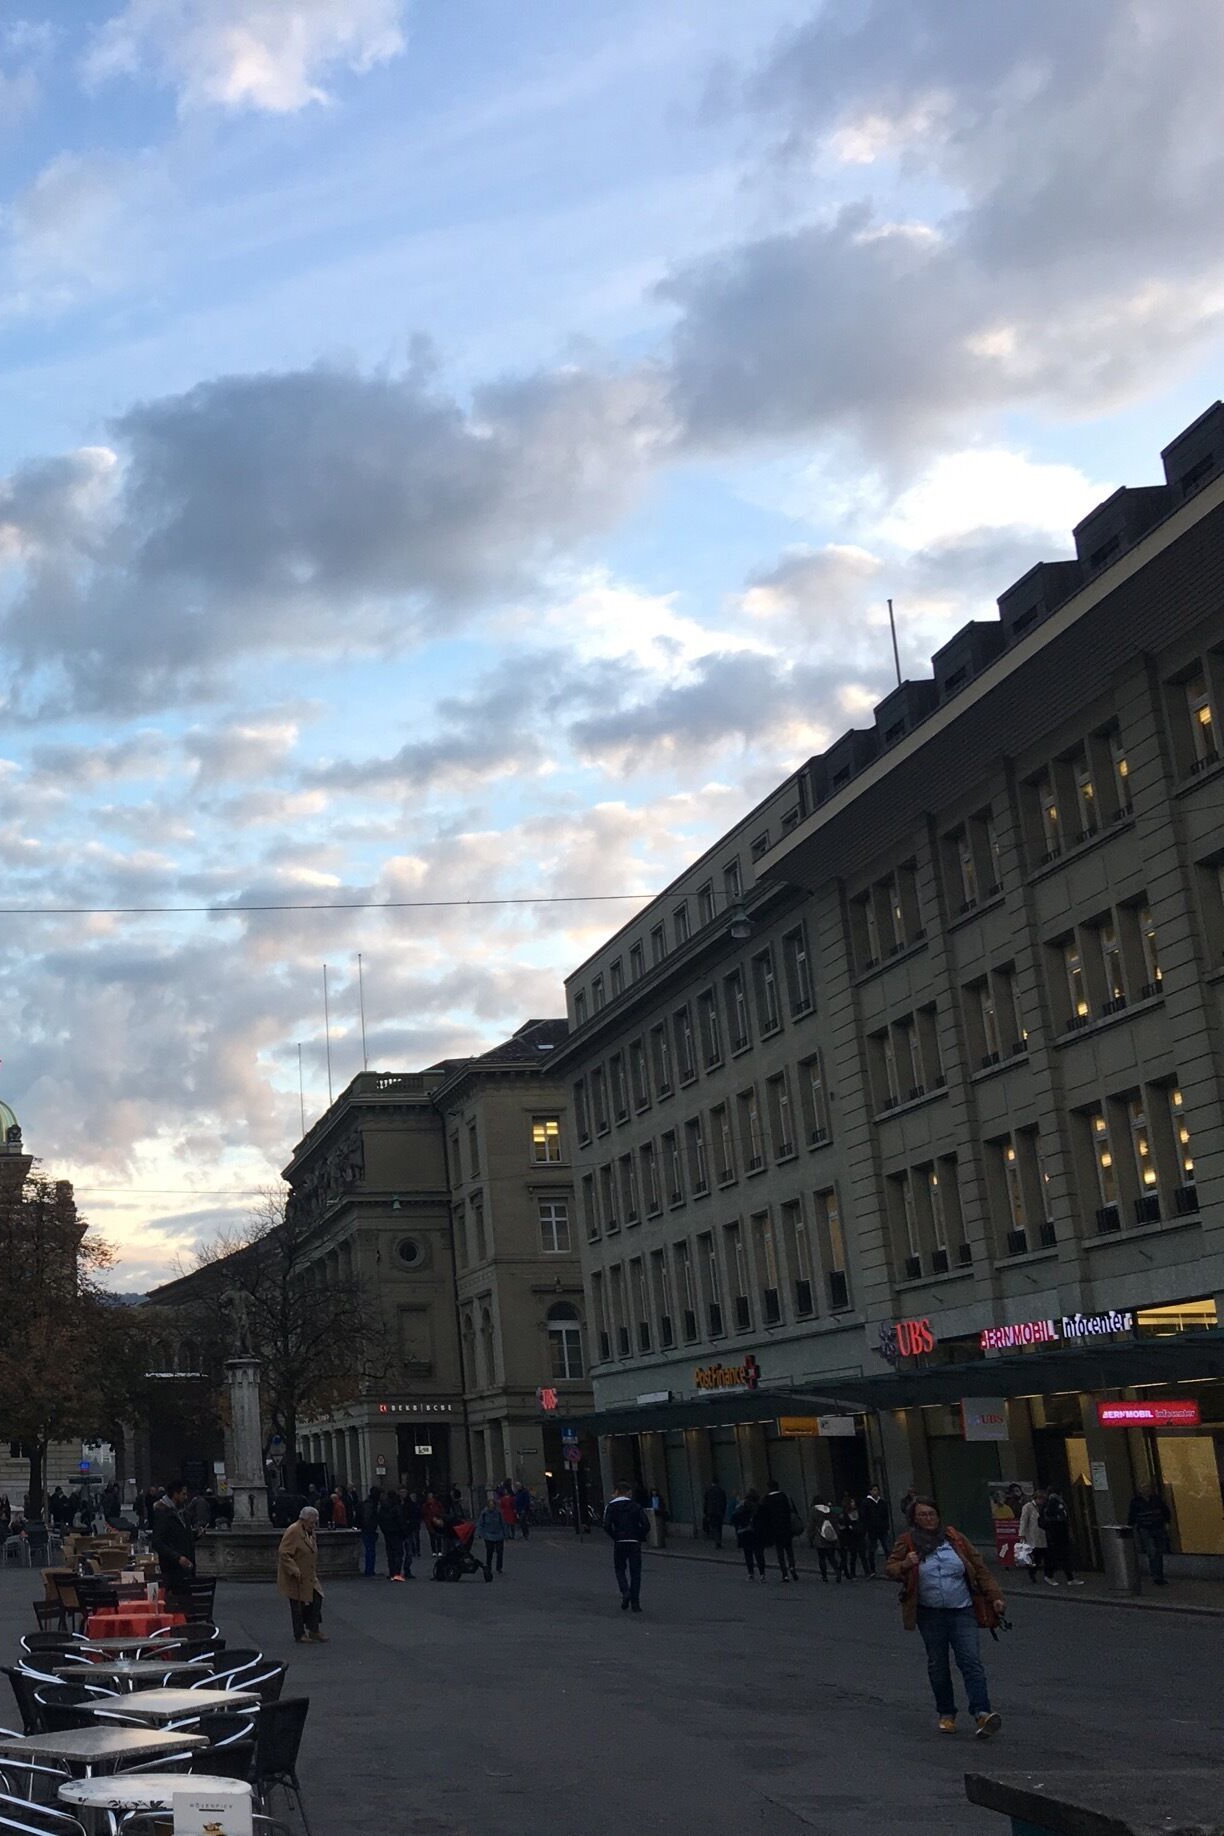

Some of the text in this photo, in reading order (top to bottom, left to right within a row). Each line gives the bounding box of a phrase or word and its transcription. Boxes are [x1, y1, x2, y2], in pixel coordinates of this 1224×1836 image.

[895, 1317, 933, 1356] UBS
[978, 1319, 1059, 1350] BERNMOBIL
[695, 1362, 746, 1390] PostFinance
[1102, 1410, 1153, 1419] BERNMOBIL
